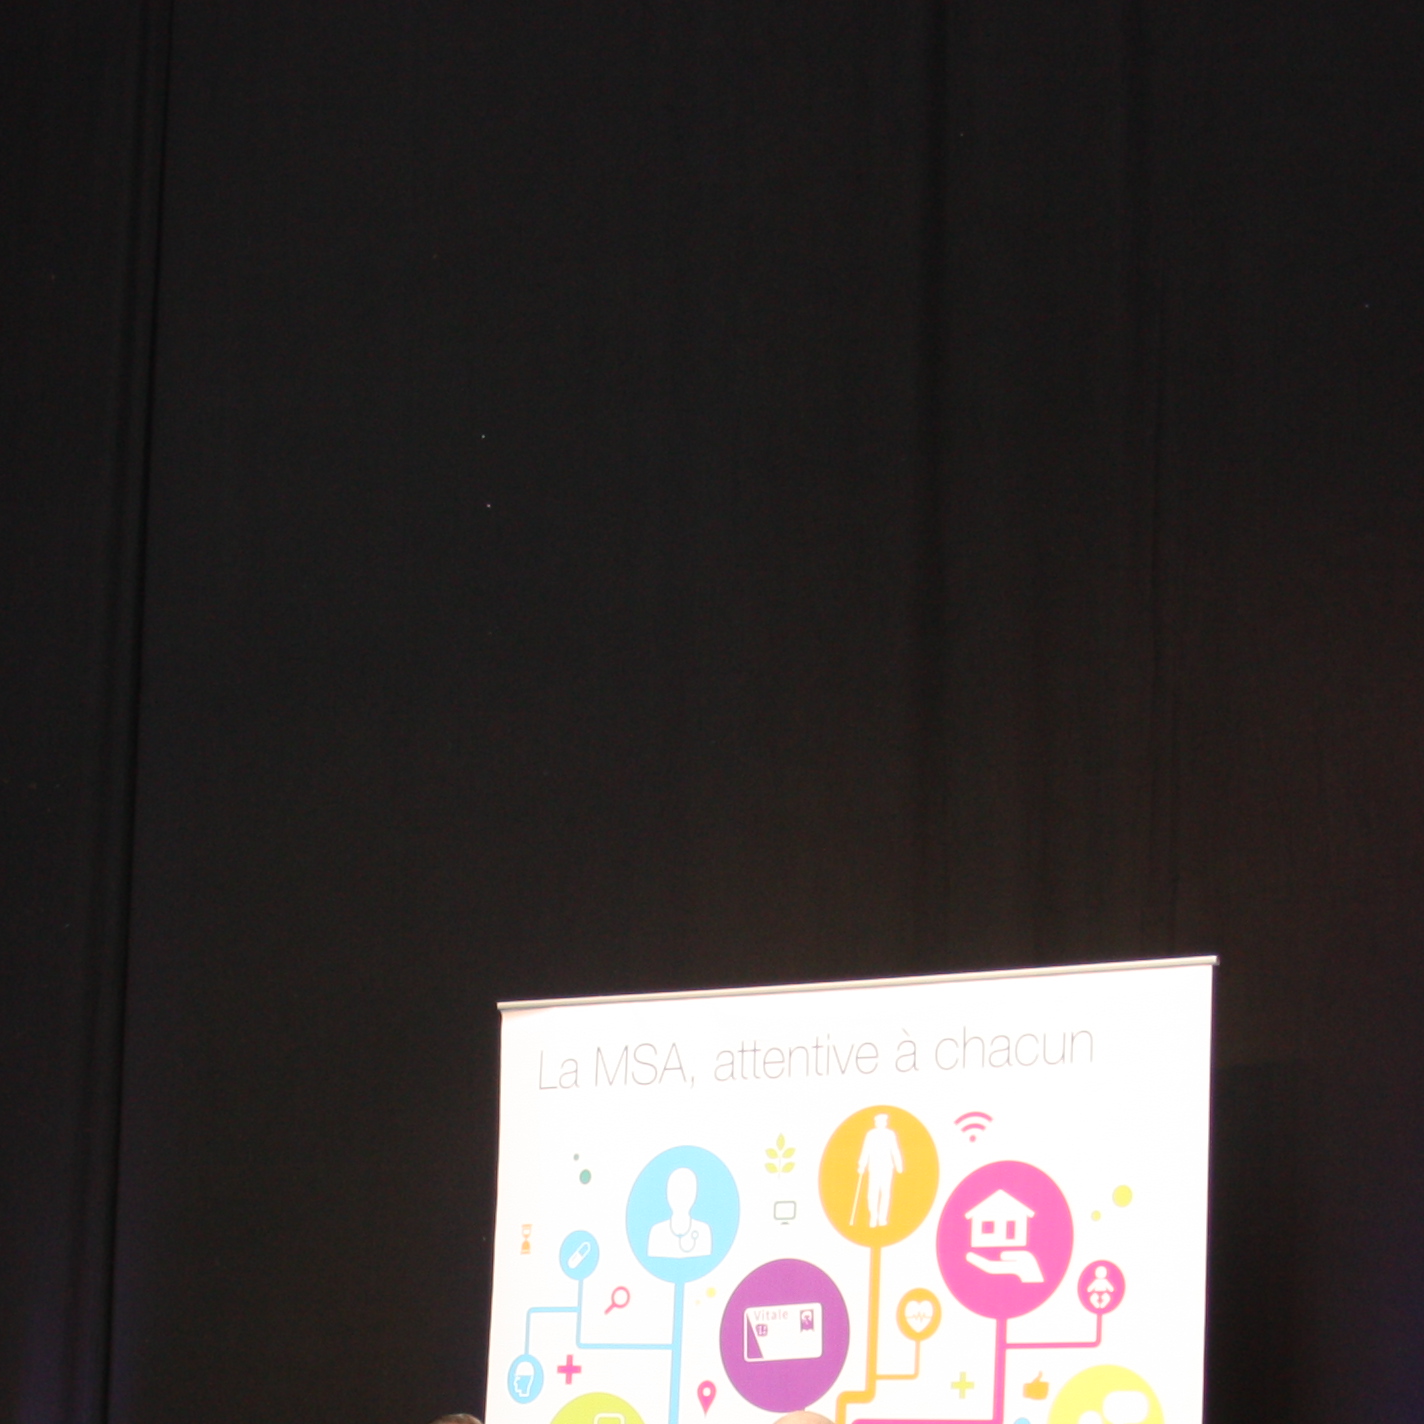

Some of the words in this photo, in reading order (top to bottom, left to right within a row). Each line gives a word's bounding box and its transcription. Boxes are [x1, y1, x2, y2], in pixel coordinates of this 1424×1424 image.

[538, 1049, 579, 1090] La
[595, 1042, 695, 1089] MSA,
[714, 1033, 879, 1082] attentive
[895, 1028, 919, 1073] à
[935, 1025, 1094, 1070] chacun
[753, 1308, 789, 1321] Vitale
